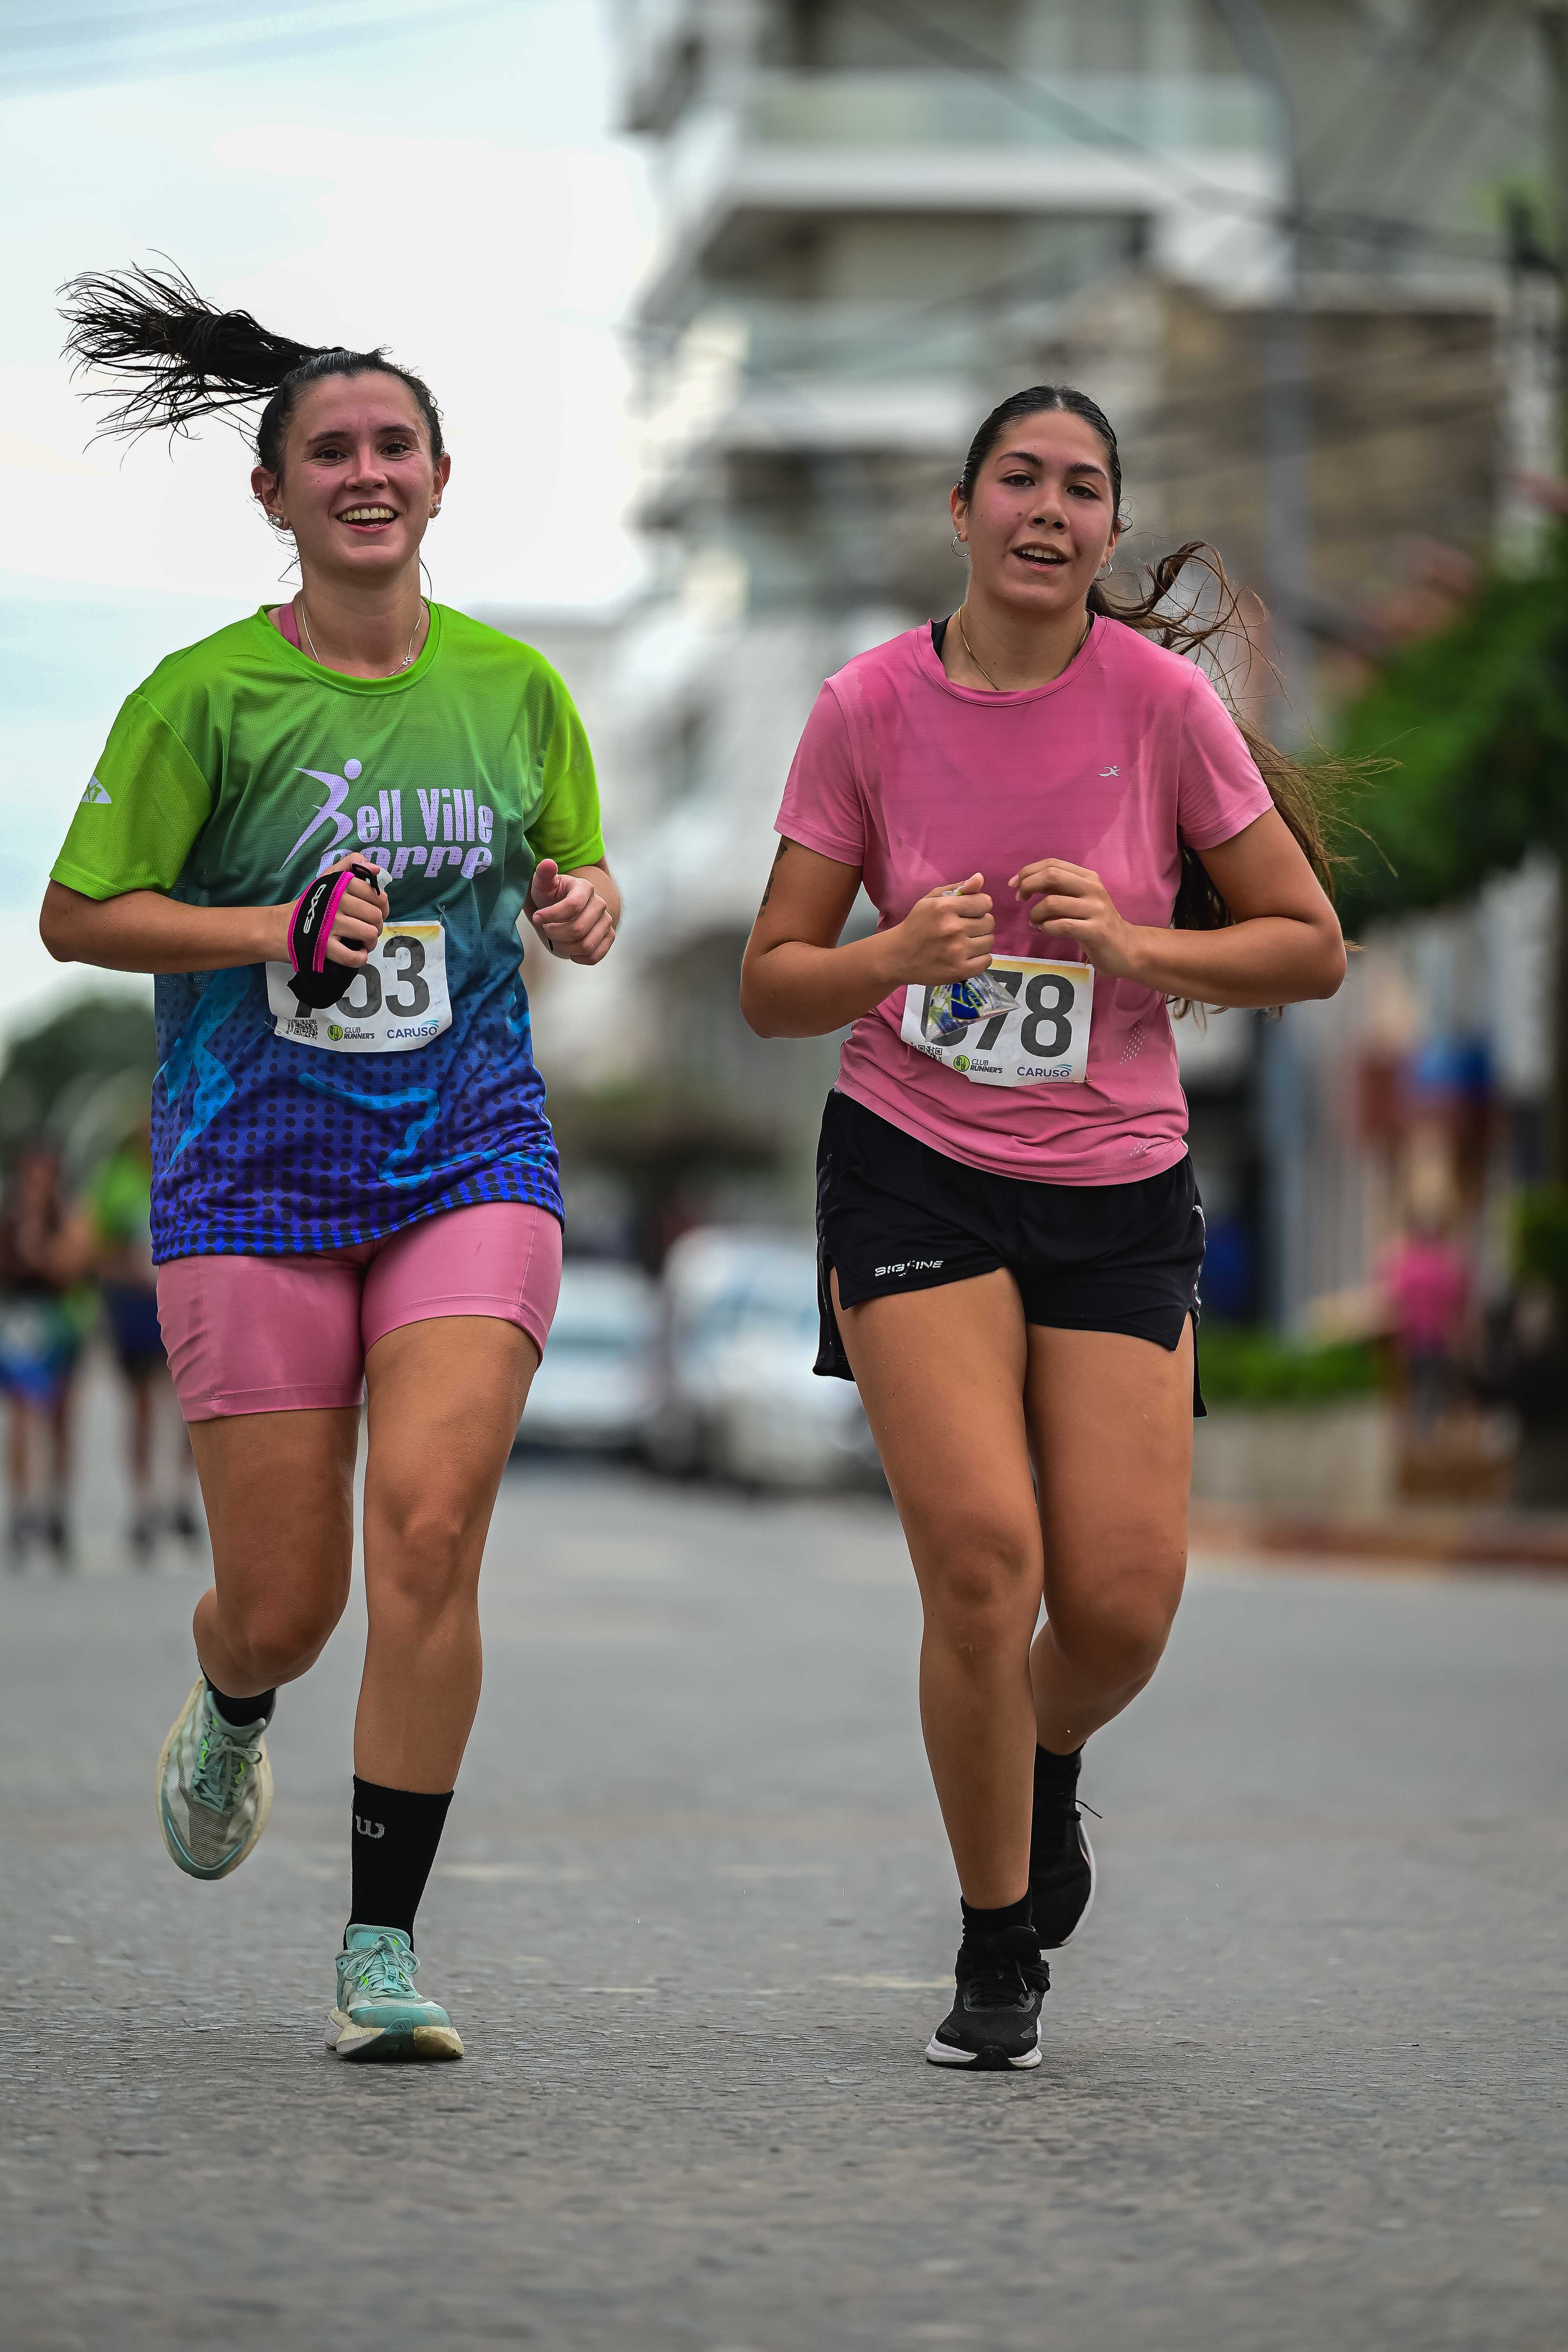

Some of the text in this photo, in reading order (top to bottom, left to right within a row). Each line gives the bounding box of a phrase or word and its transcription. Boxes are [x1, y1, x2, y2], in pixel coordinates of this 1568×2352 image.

[416, 789, 494, 843] Ville
[387, 1026, 438, 1039] CARUSO
[970, 1064, 1003, 1074] RUNNER'S
[1017, 1066, 1070, 1077] CARUSO
